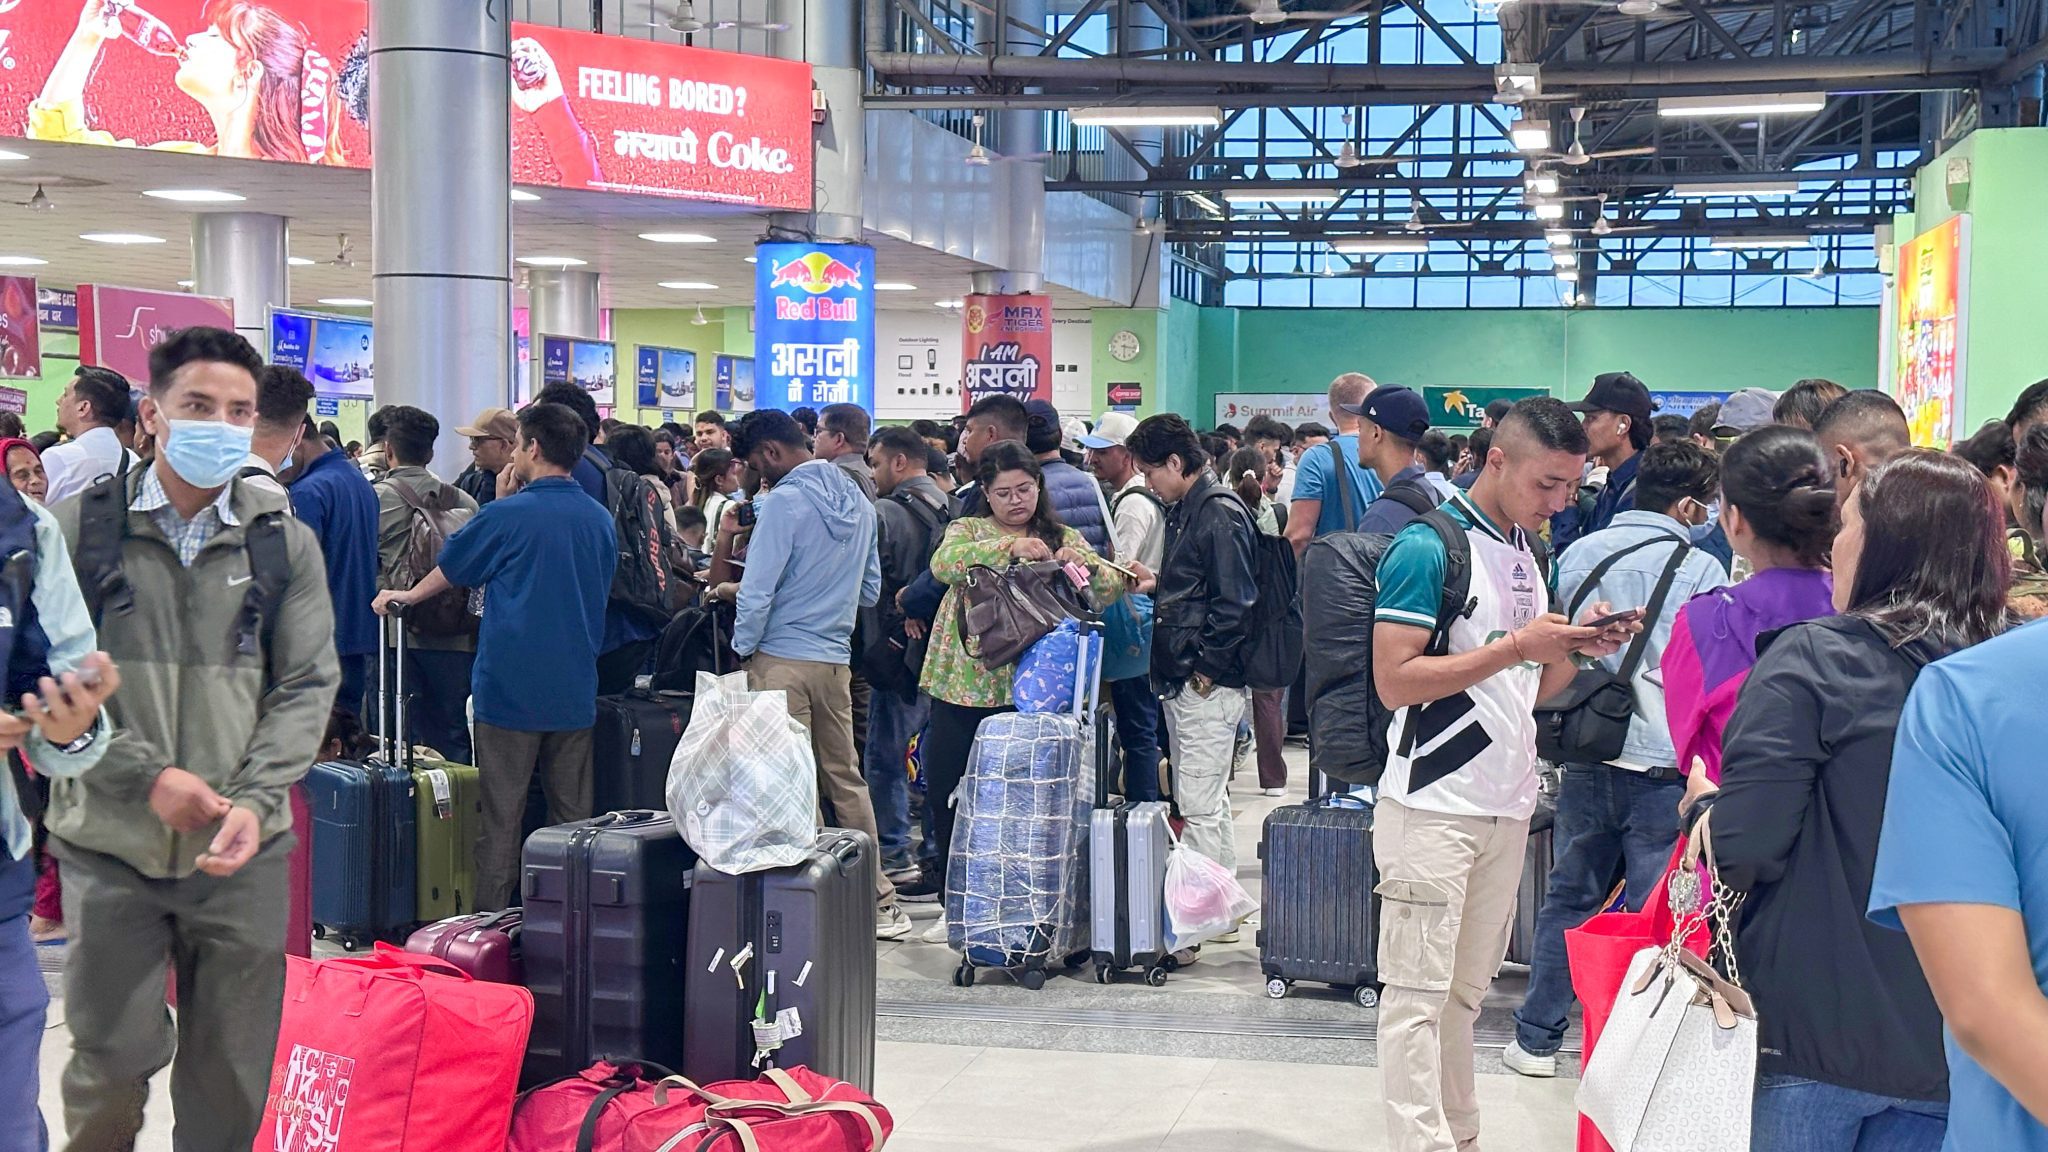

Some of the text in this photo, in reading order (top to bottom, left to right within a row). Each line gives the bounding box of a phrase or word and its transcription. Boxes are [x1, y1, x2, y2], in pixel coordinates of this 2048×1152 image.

[578, 67, 748, 117] FEELING BORED?
[776, 296, 857, 321] Red Bull
[1004, 306, 1042, 318] MAX
[1004, 319, 1043, 327] TIGER
[771, 337, 860, 377] असली
[980, 344, 1019, 361] I AM
[965, 357, 1038, 389] असली
[1240, 405, 1319, 417] Summit Air
